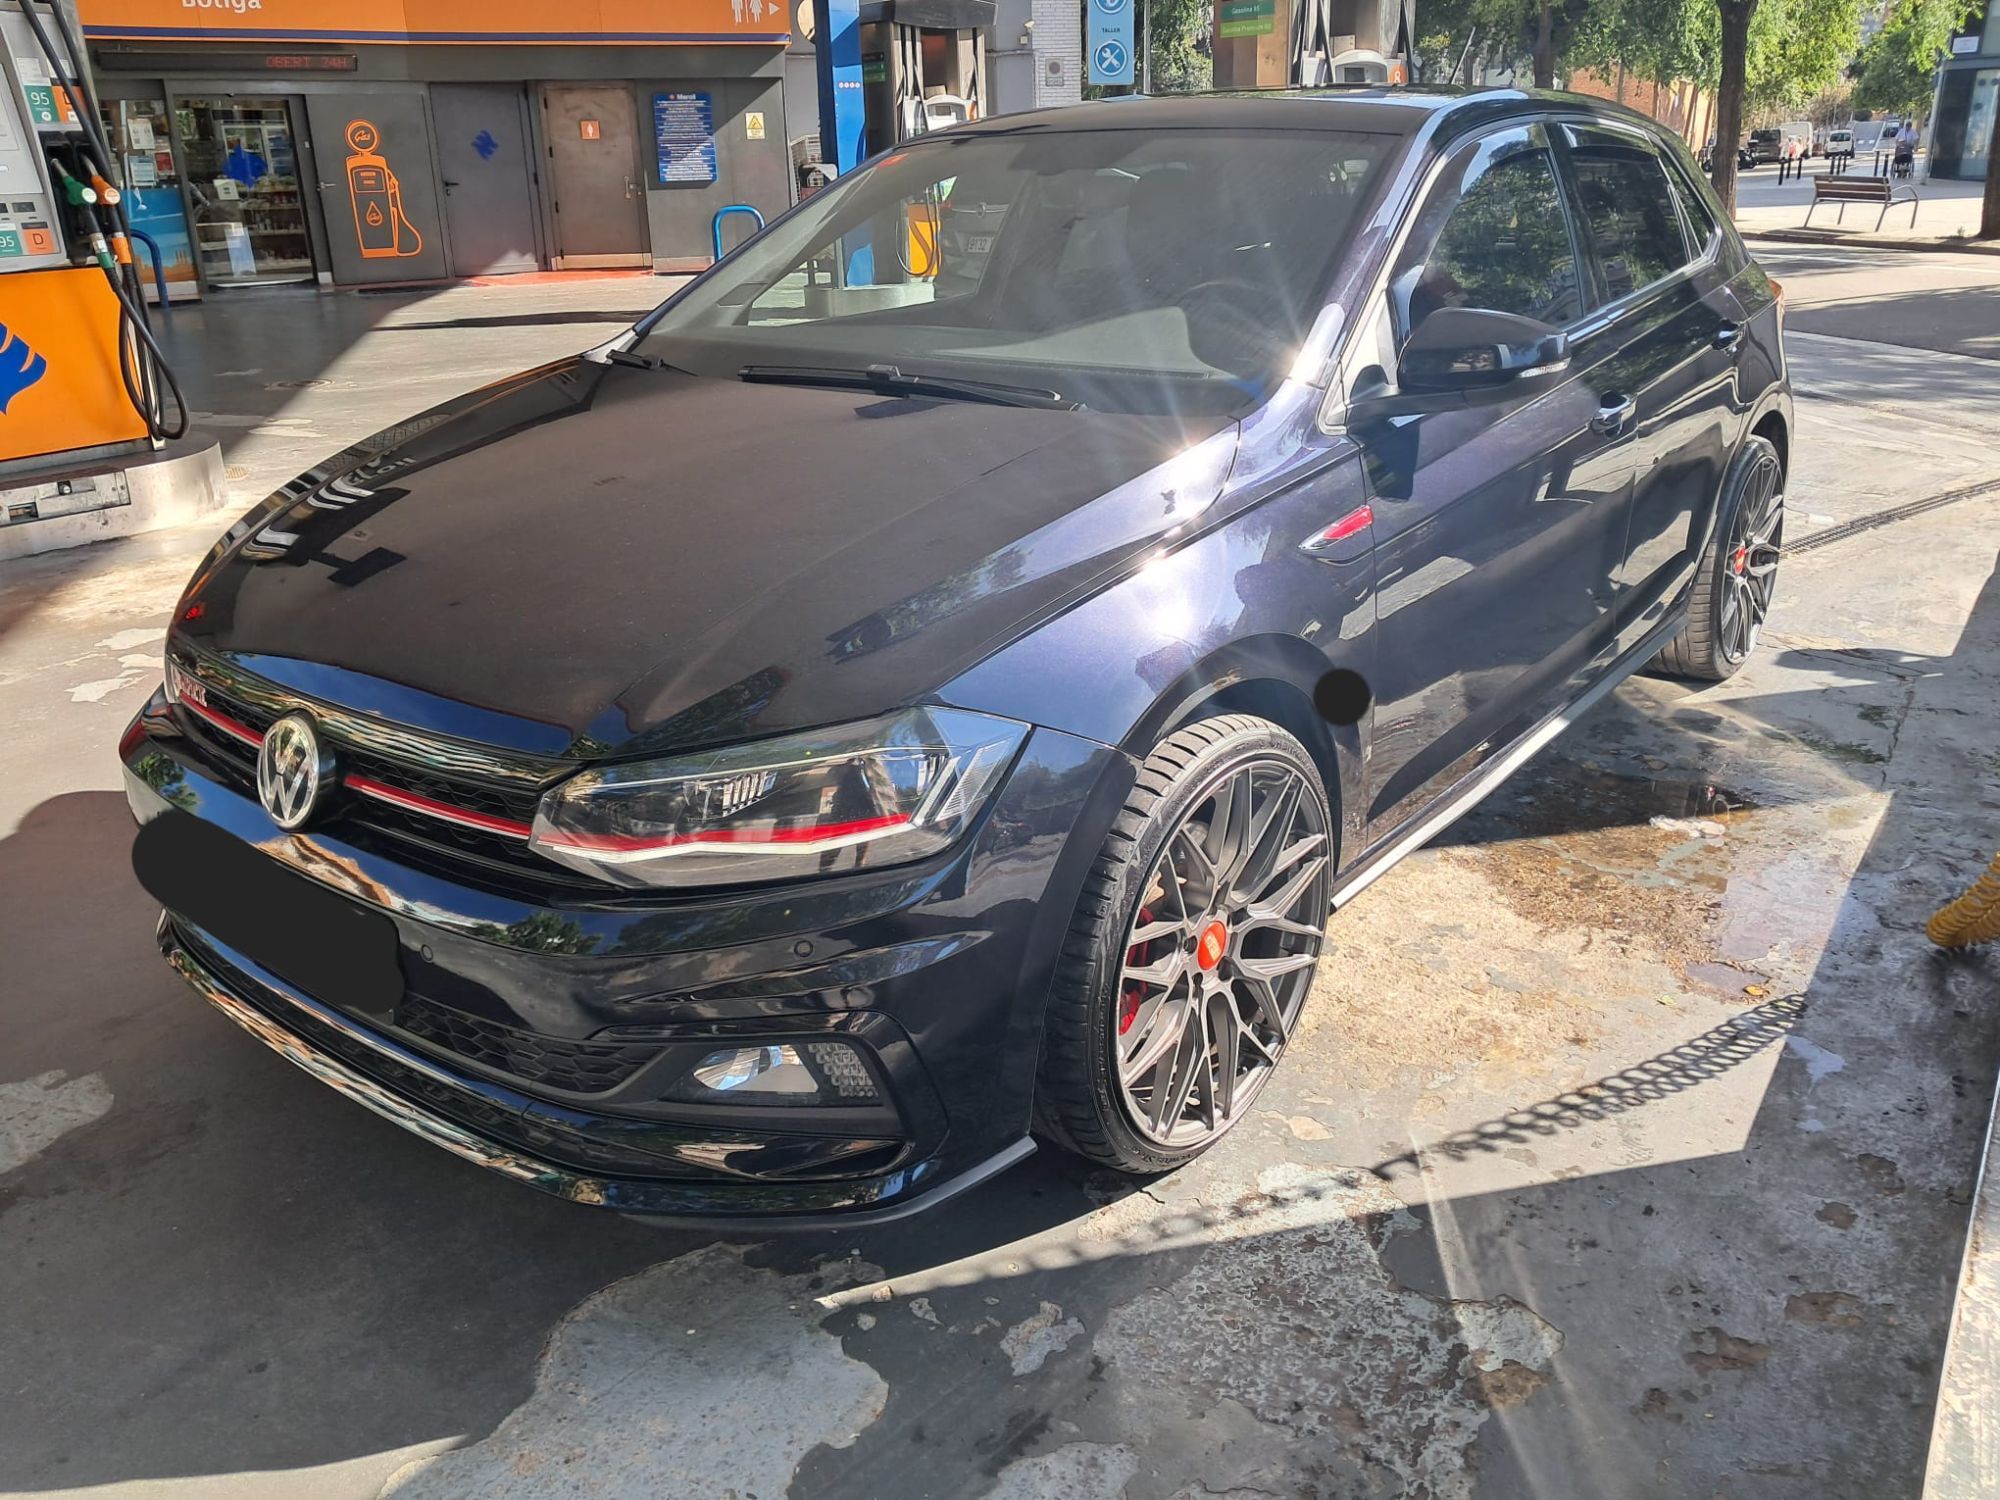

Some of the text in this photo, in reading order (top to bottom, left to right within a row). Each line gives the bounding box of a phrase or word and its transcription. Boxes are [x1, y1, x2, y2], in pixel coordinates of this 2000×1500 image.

[266, 56, 311, 68] OBERT
[30, 91, 50, 105] 95
[0, 235, 15, 248] 95
[33, 233, 44, 245] D
